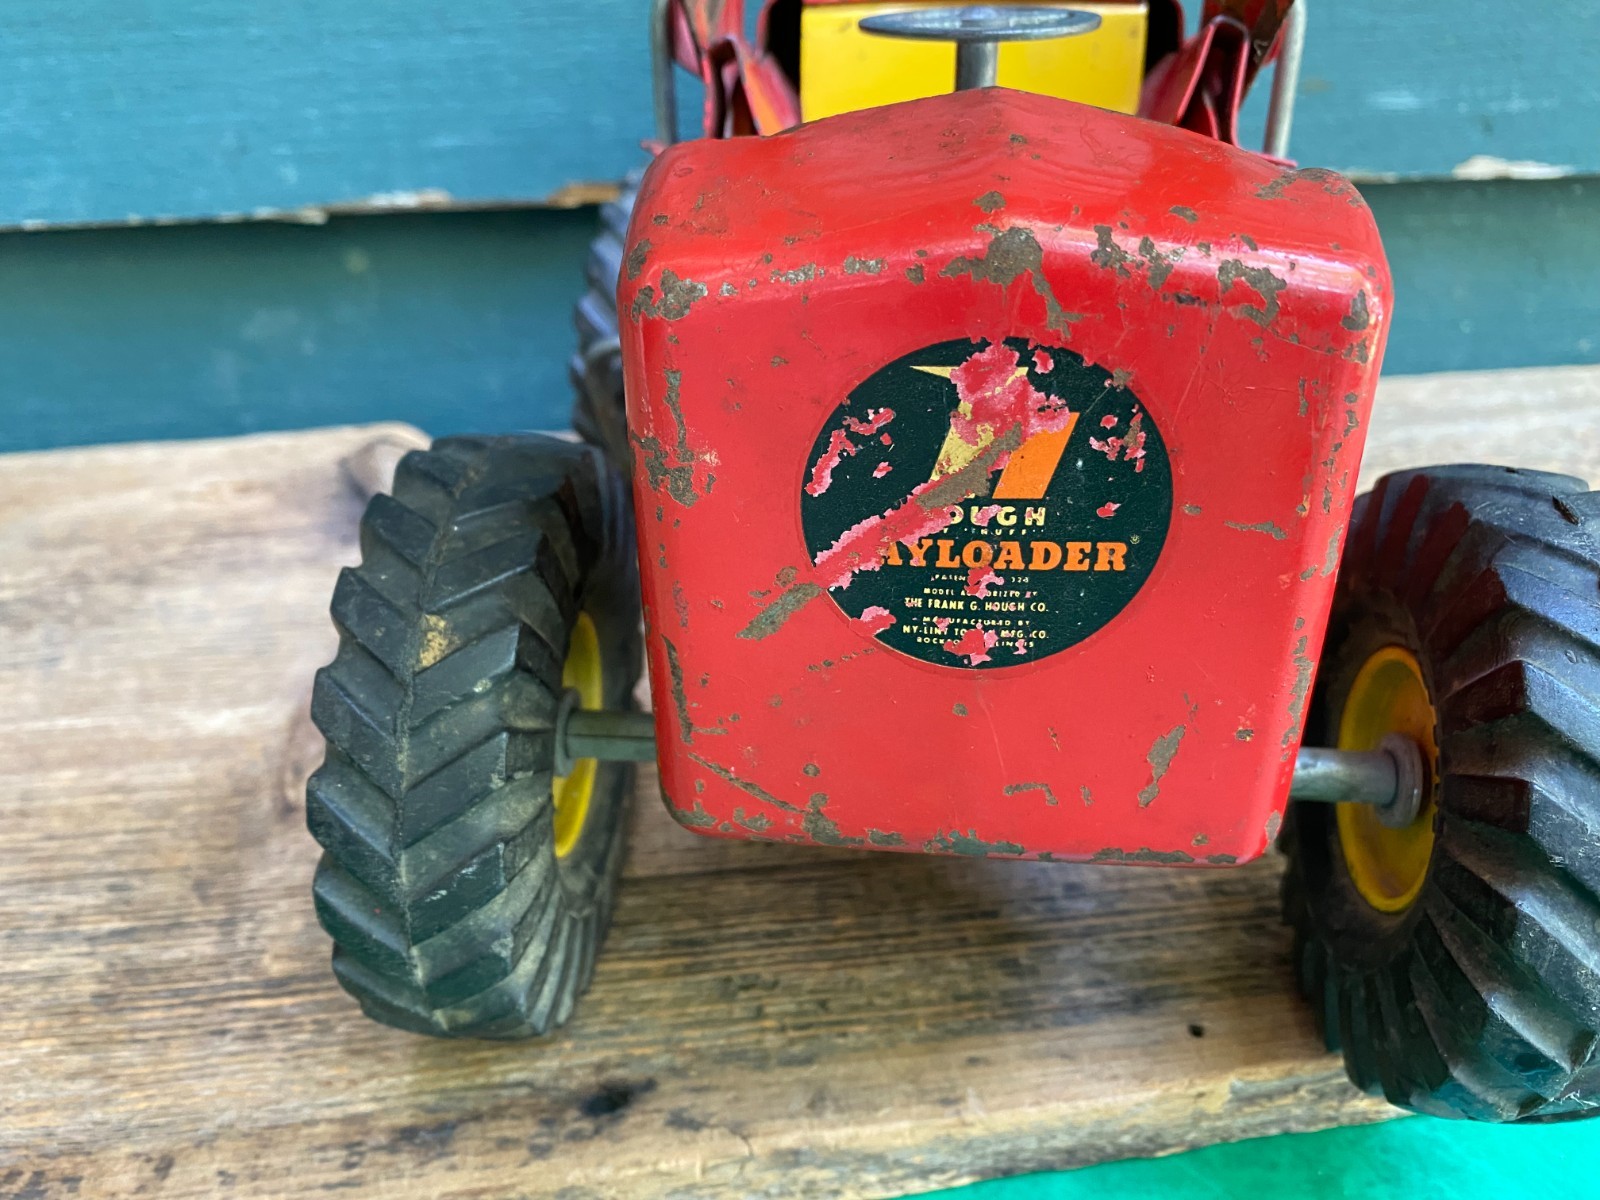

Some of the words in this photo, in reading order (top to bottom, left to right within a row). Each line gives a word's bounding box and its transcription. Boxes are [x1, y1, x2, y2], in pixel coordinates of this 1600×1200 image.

[936, 505, 1046, 526] OUGH
[880, 538, 1128, 571] AYLOADER
[923, 588, 954, 596] MODEL
[904, 597, 923, 608] THE
[928, 599, 964, 611] FRANK
[970, 601, 981, 611] G.
[985, 602, 1025, 612] HOUGH
[1030, 603, 1049, 612] CO.
[1032, 630, 1050, 639] CO.
